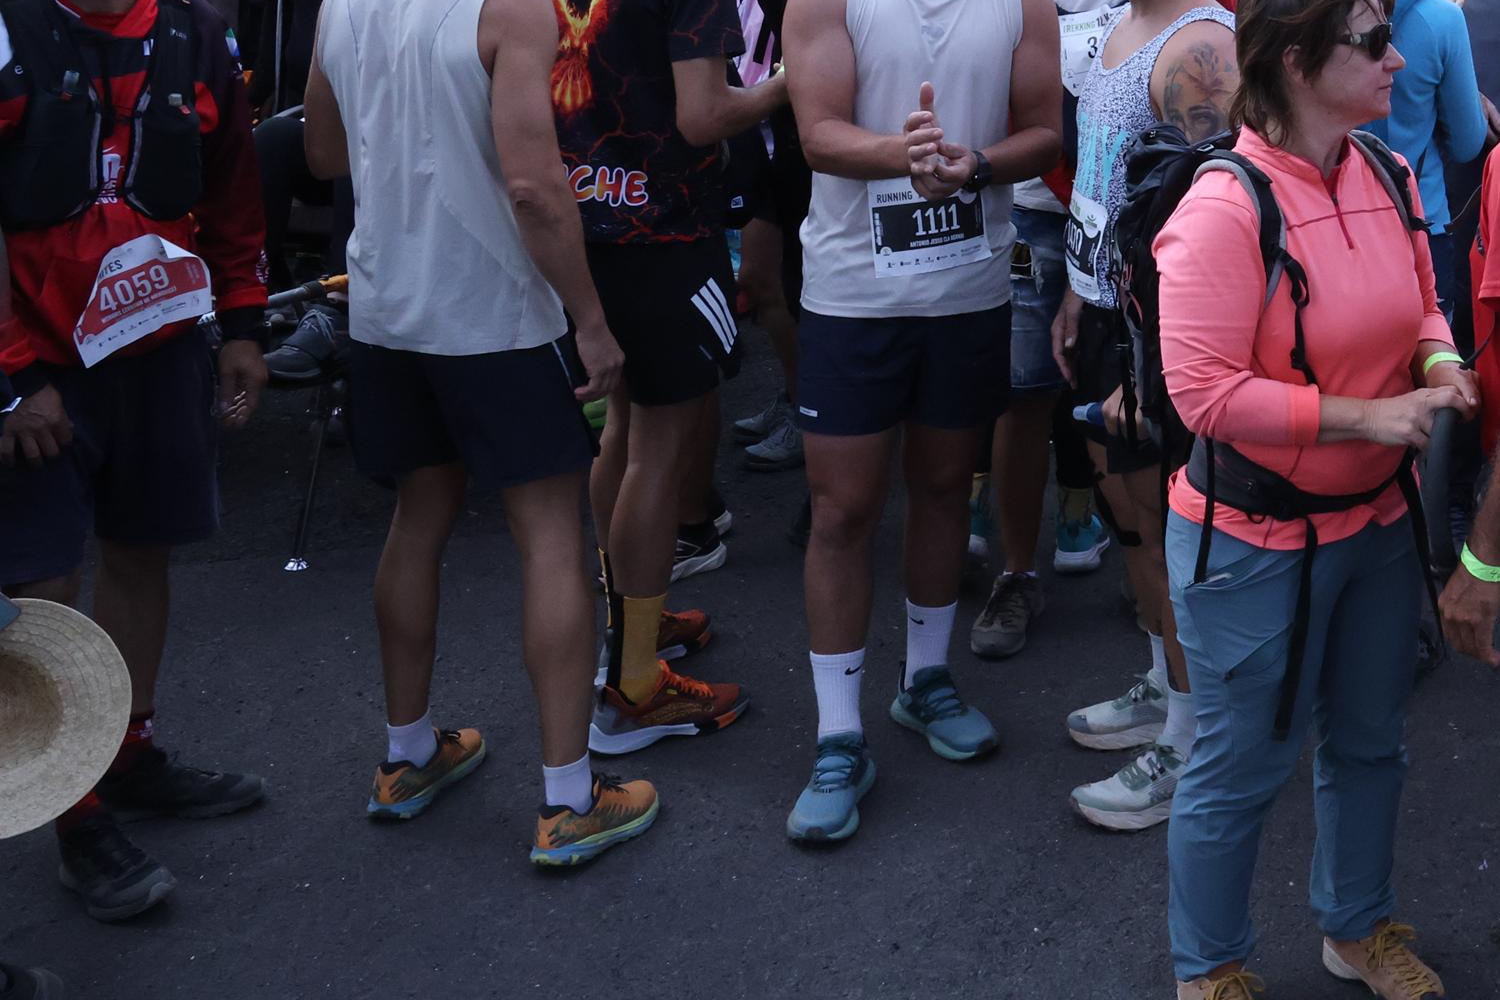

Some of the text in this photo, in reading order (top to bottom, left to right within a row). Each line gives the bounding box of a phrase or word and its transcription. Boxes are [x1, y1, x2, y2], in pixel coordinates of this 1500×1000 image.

[562, 164, 649, 207] CHE
[876, 190, 913, 204] RUNNING
[912, 203, 961, 236] 1111
[100, 264, 170, 312] 4059
